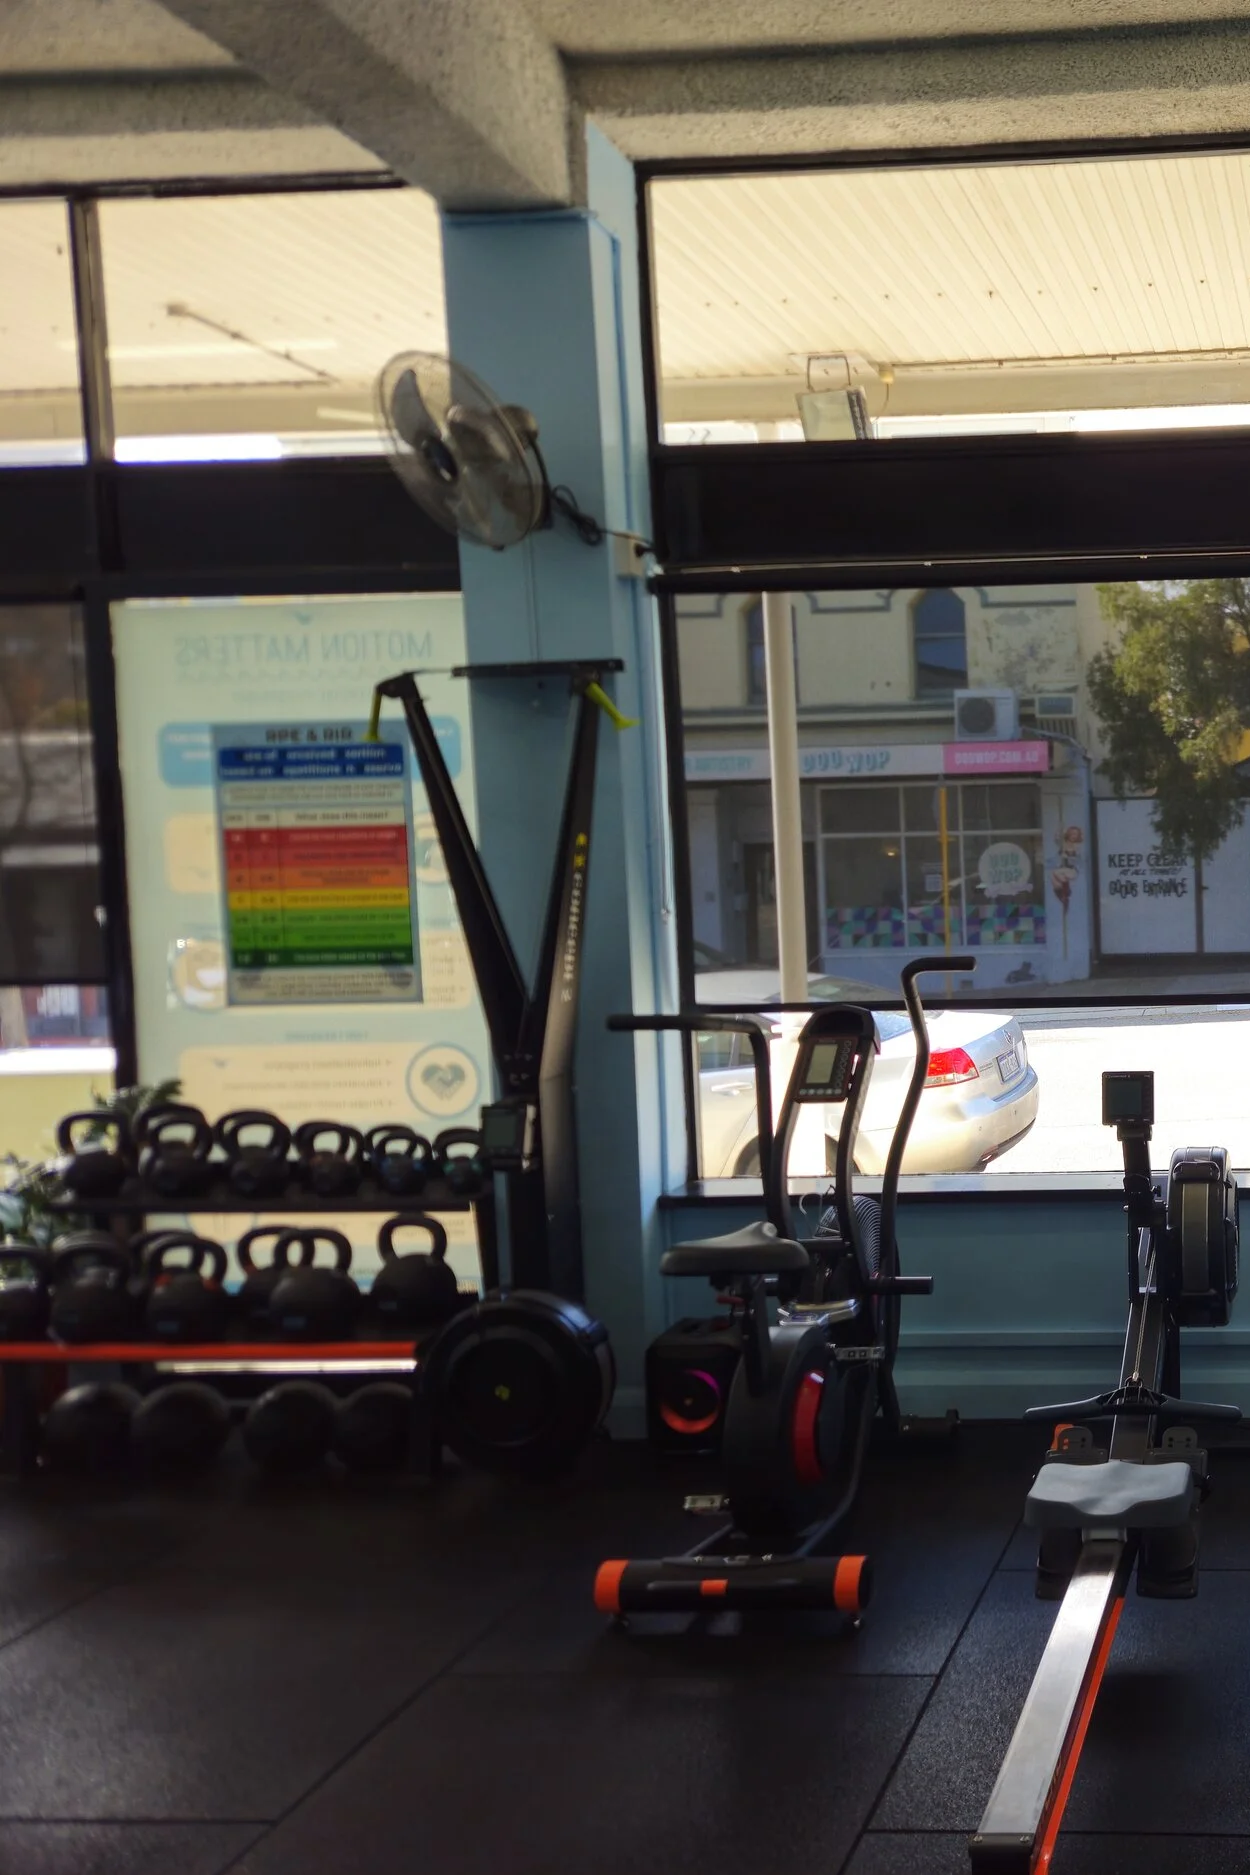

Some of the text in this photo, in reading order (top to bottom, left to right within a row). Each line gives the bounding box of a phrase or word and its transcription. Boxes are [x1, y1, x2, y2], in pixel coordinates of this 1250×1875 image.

[1108, 853, 1188, 868] KEEP CLEAR
[1109, 877, 1189, 899] GOODS ENTRANCE
